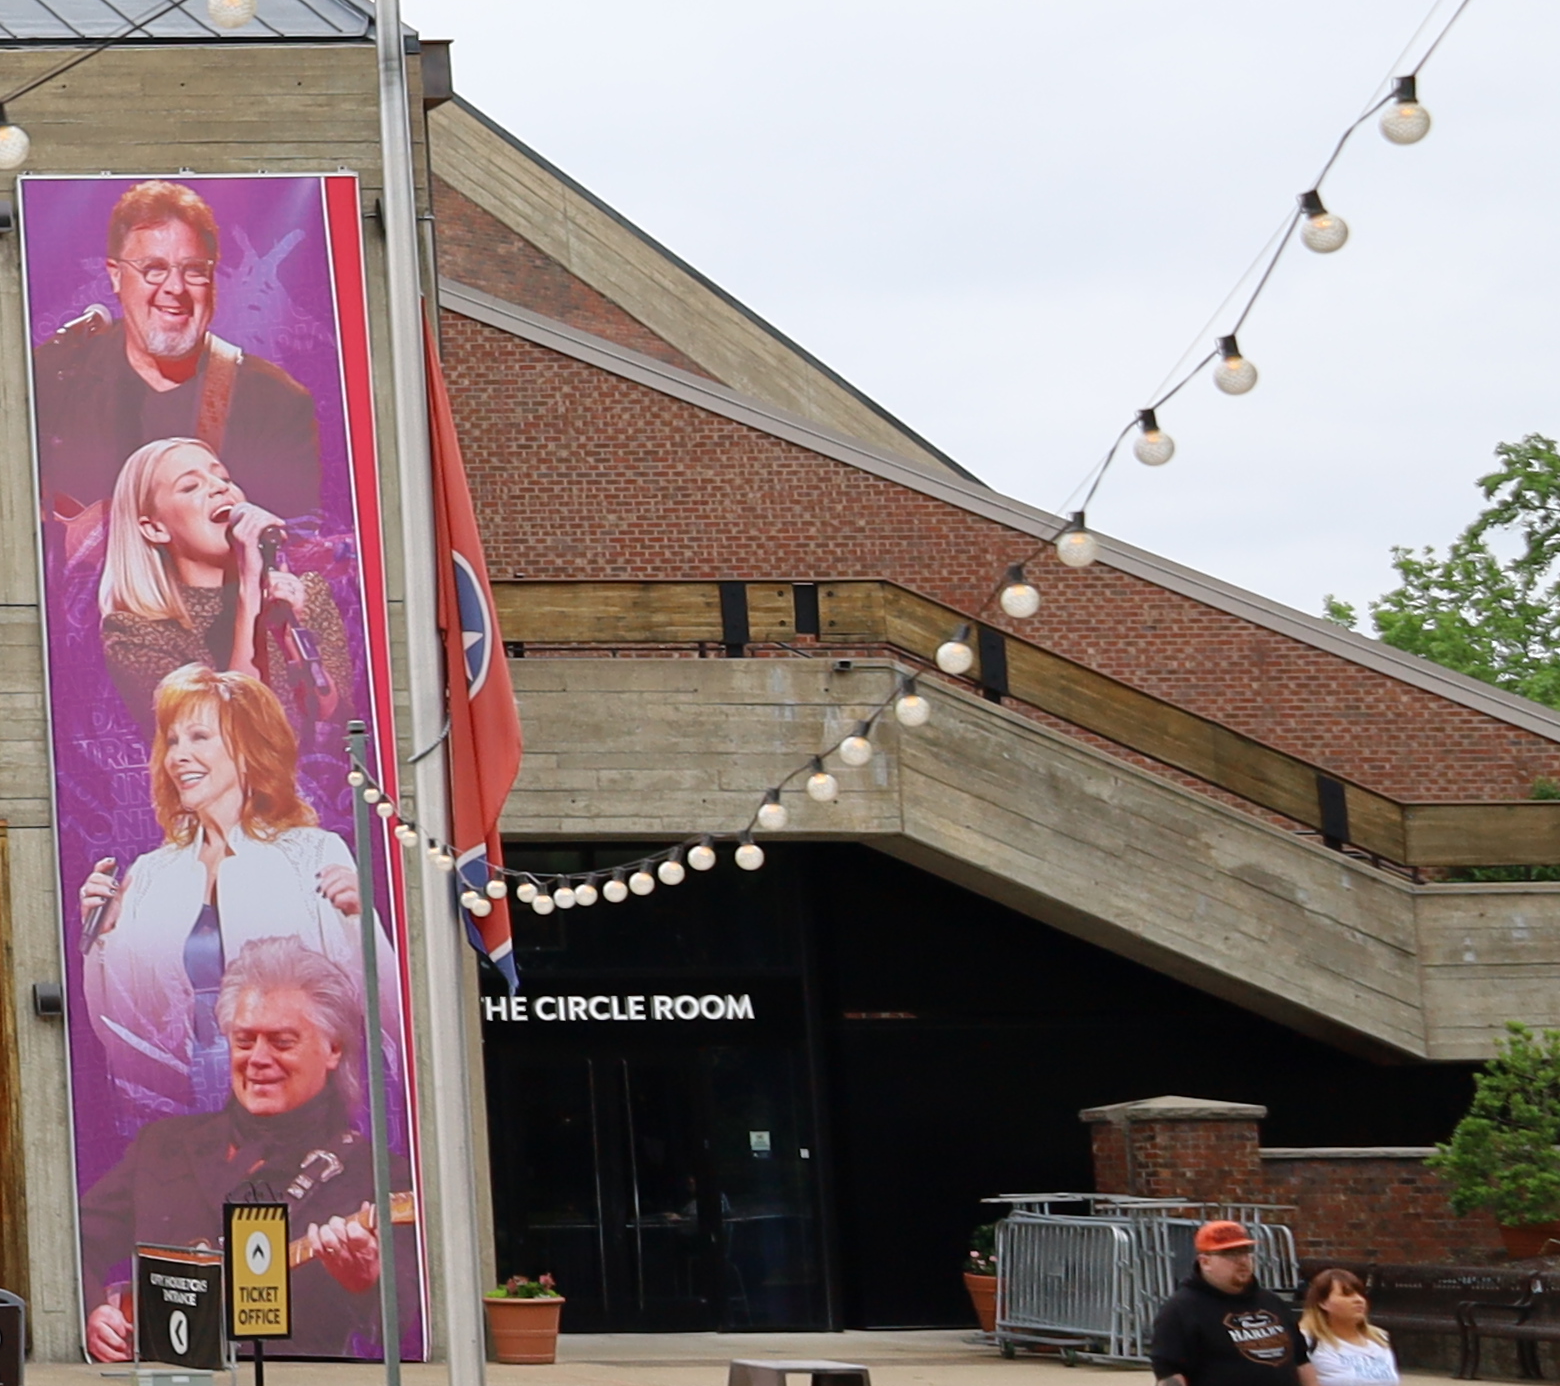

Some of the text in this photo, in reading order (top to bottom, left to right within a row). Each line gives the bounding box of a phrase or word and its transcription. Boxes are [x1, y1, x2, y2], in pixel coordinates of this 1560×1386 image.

[533, 995, 645, 1021] CIRCLE
[651, 993, 756, 1020] ROOM
[239, 1286, 279, 1303] TICKET
[238, 1309, 281, 1325] OFFICE
[1227, 1324, 1284, 1342] HARLEY
